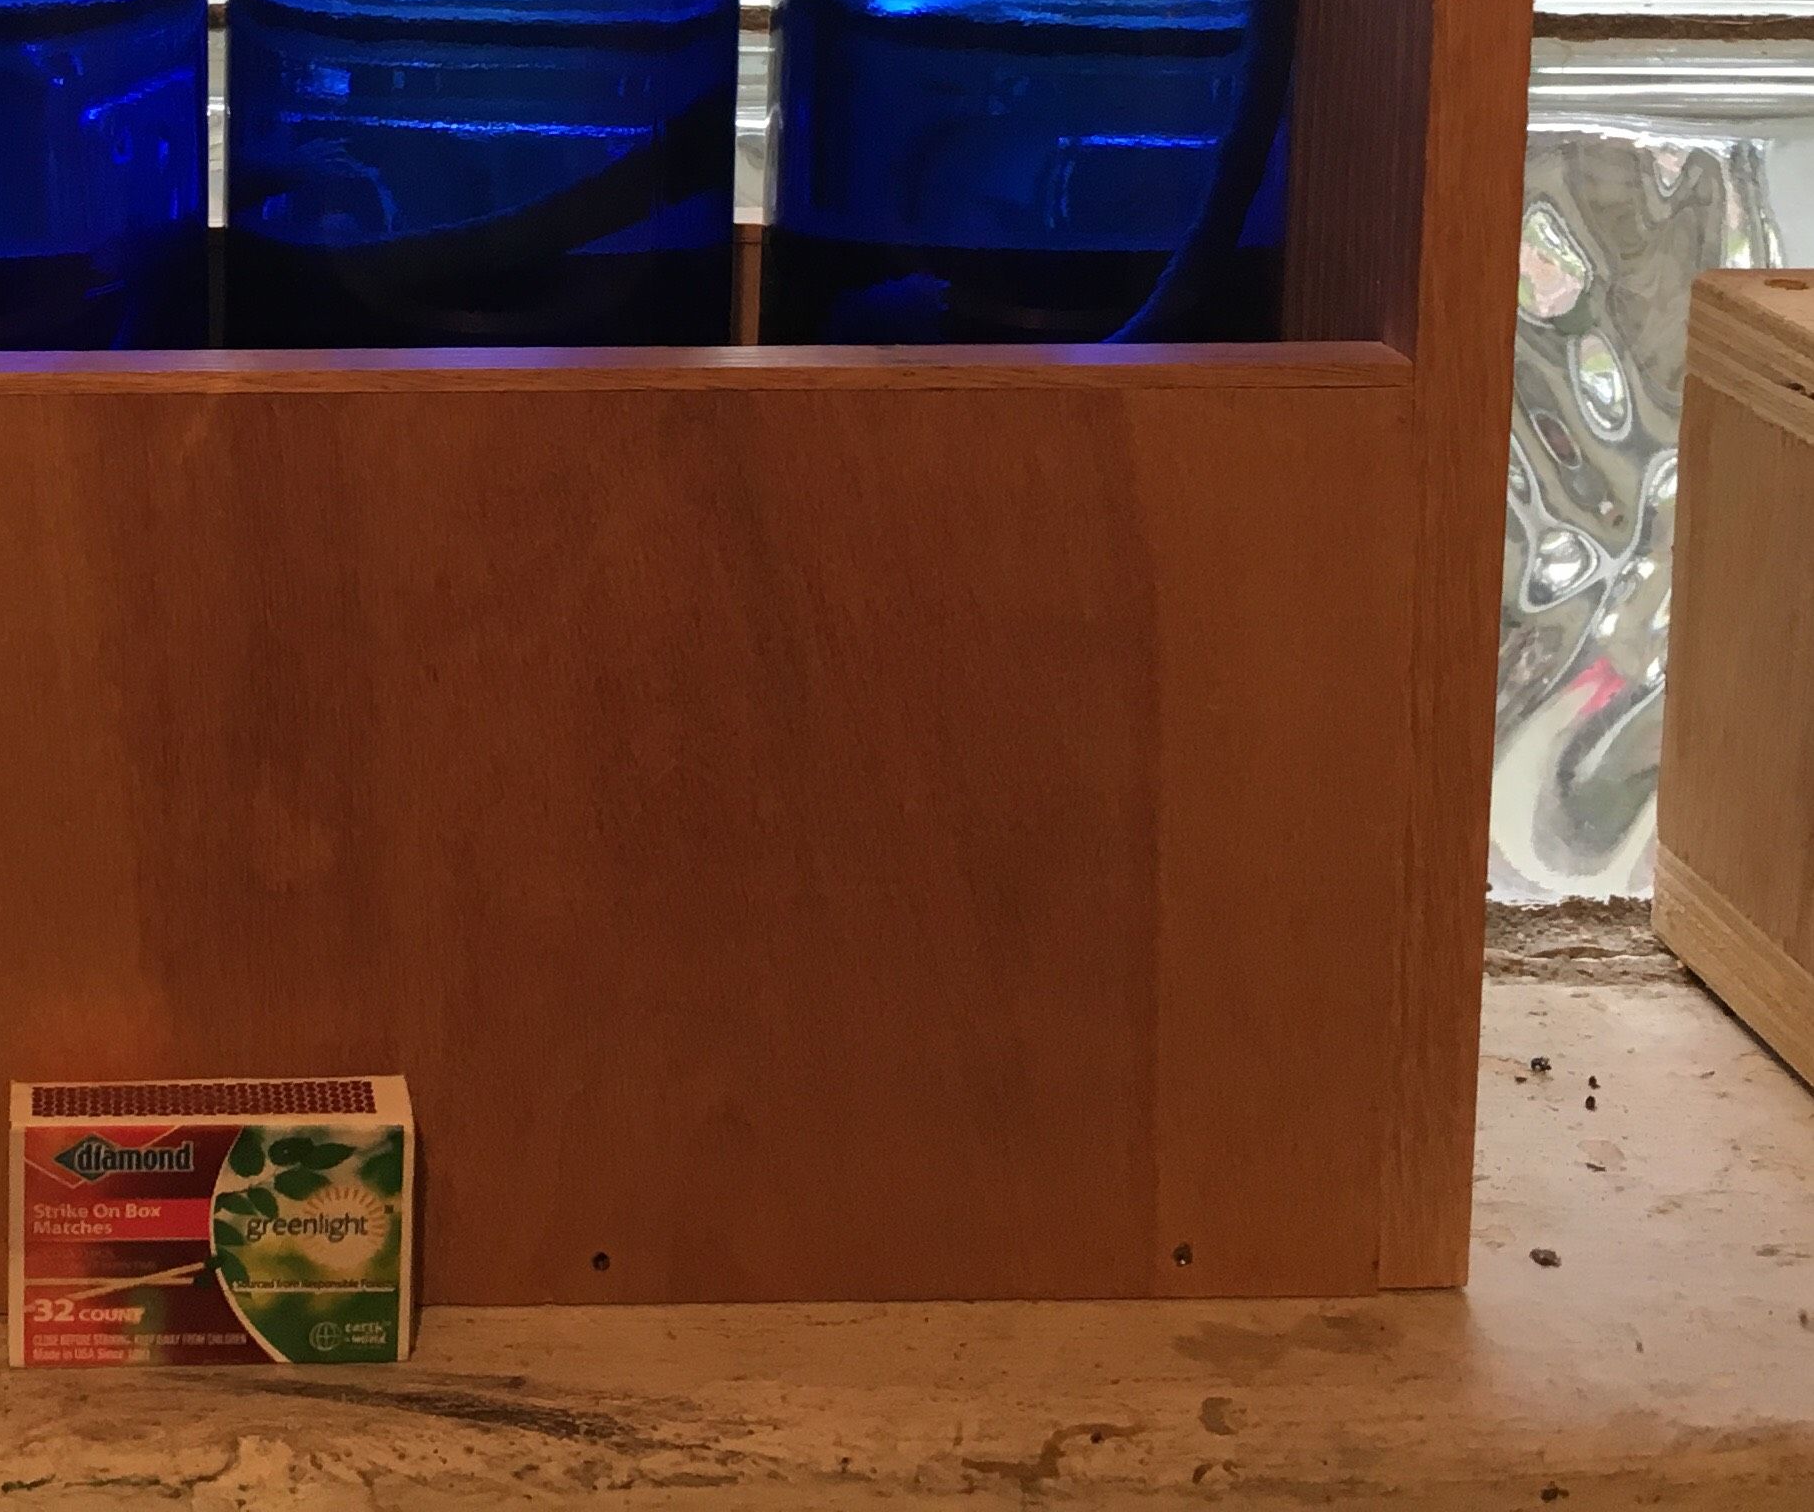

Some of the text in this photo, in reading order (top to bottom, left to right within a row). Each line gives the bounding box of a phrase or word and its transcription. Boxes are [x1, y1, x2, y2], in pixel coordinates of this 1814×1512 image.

[74, 1141, 194, 1172] diamond
[33, 1203, 162, 1218] Strike On Box
[33, 1220, 113, 1235] Matches
[246, 1212, 368, 1243] greenlight
[34, 1299, 145, 1324] 32 COUNT
